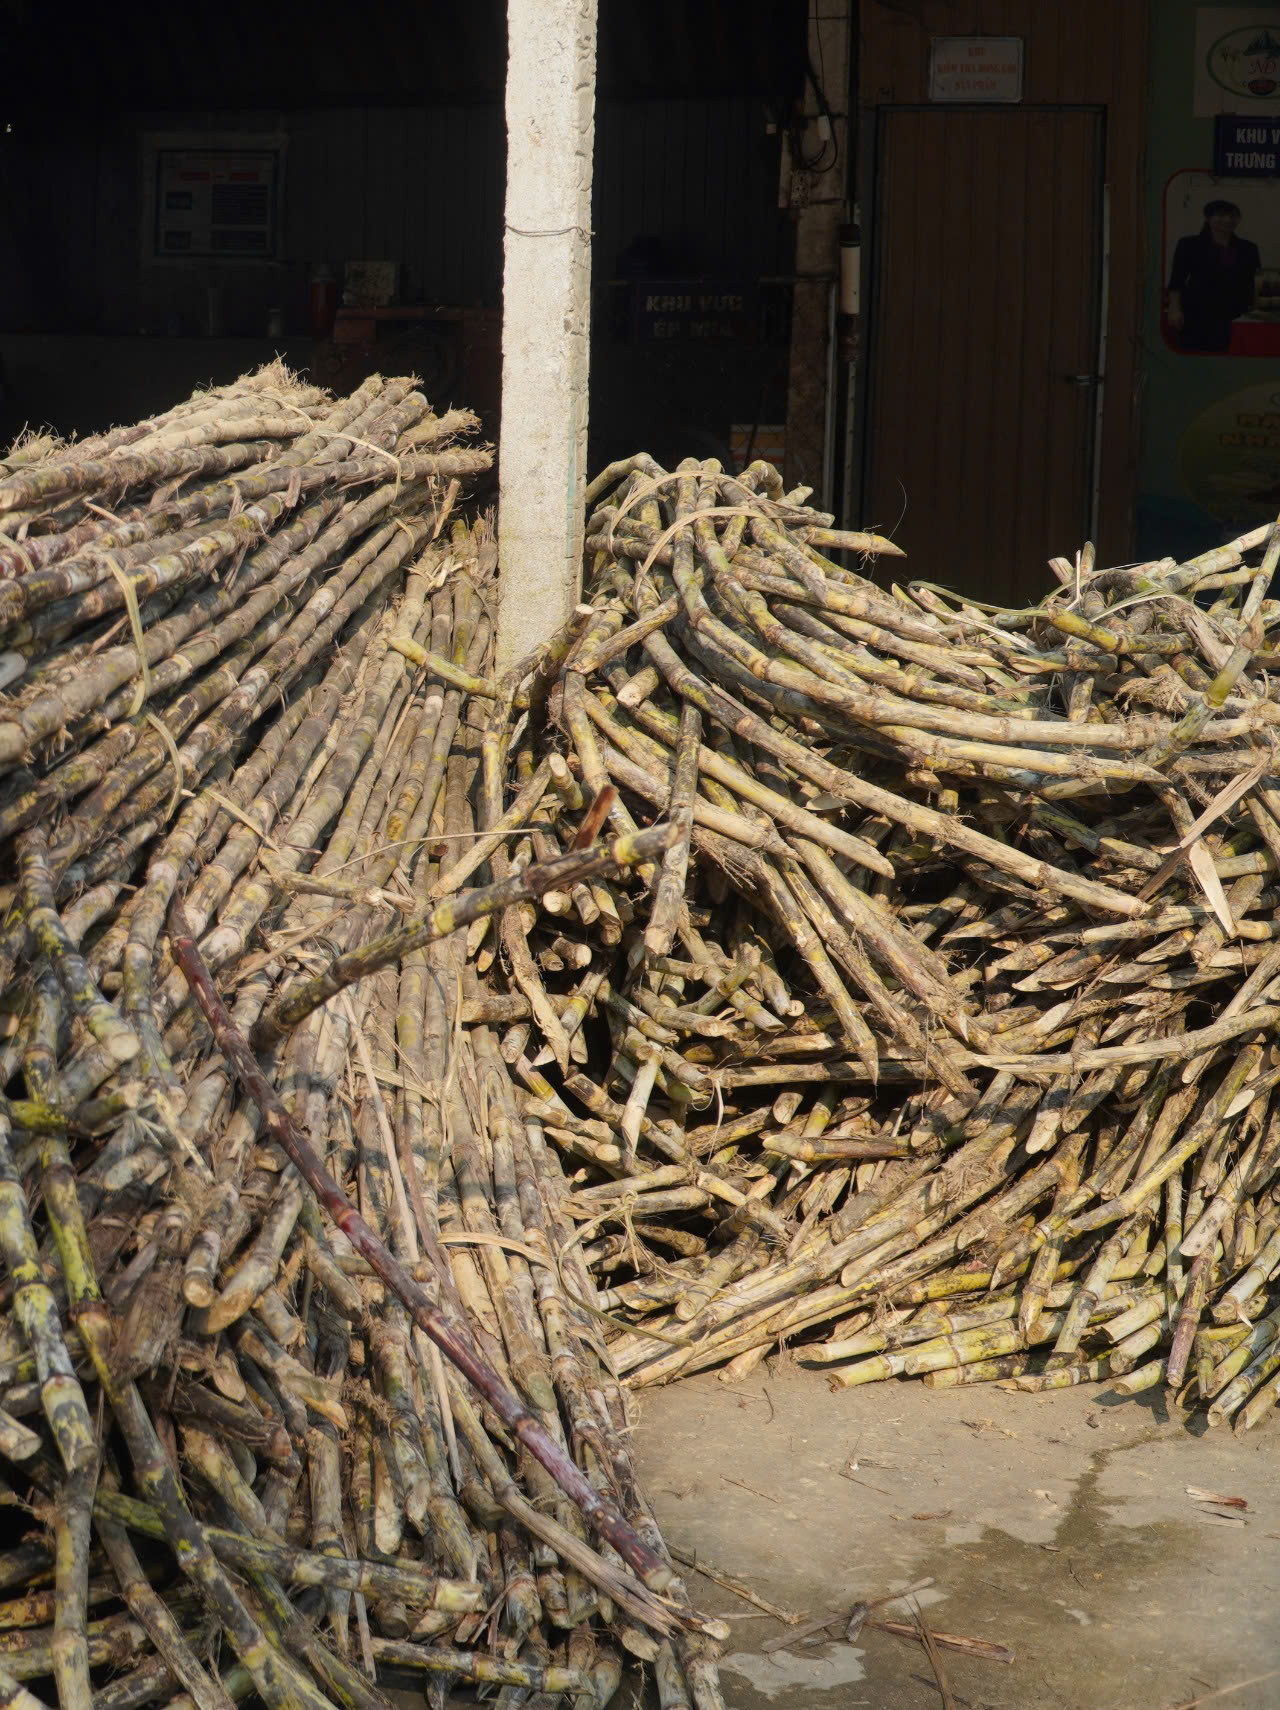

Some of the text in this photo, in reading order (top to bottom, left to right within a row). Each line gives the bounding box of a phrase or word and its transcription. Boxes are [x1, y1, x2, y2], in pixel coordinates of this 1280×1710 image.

[1236, 127, 1267, 144] KHU
[1225, 151, 1276, 169] TRƯNG
[646, 295, 690, 312] KHU
